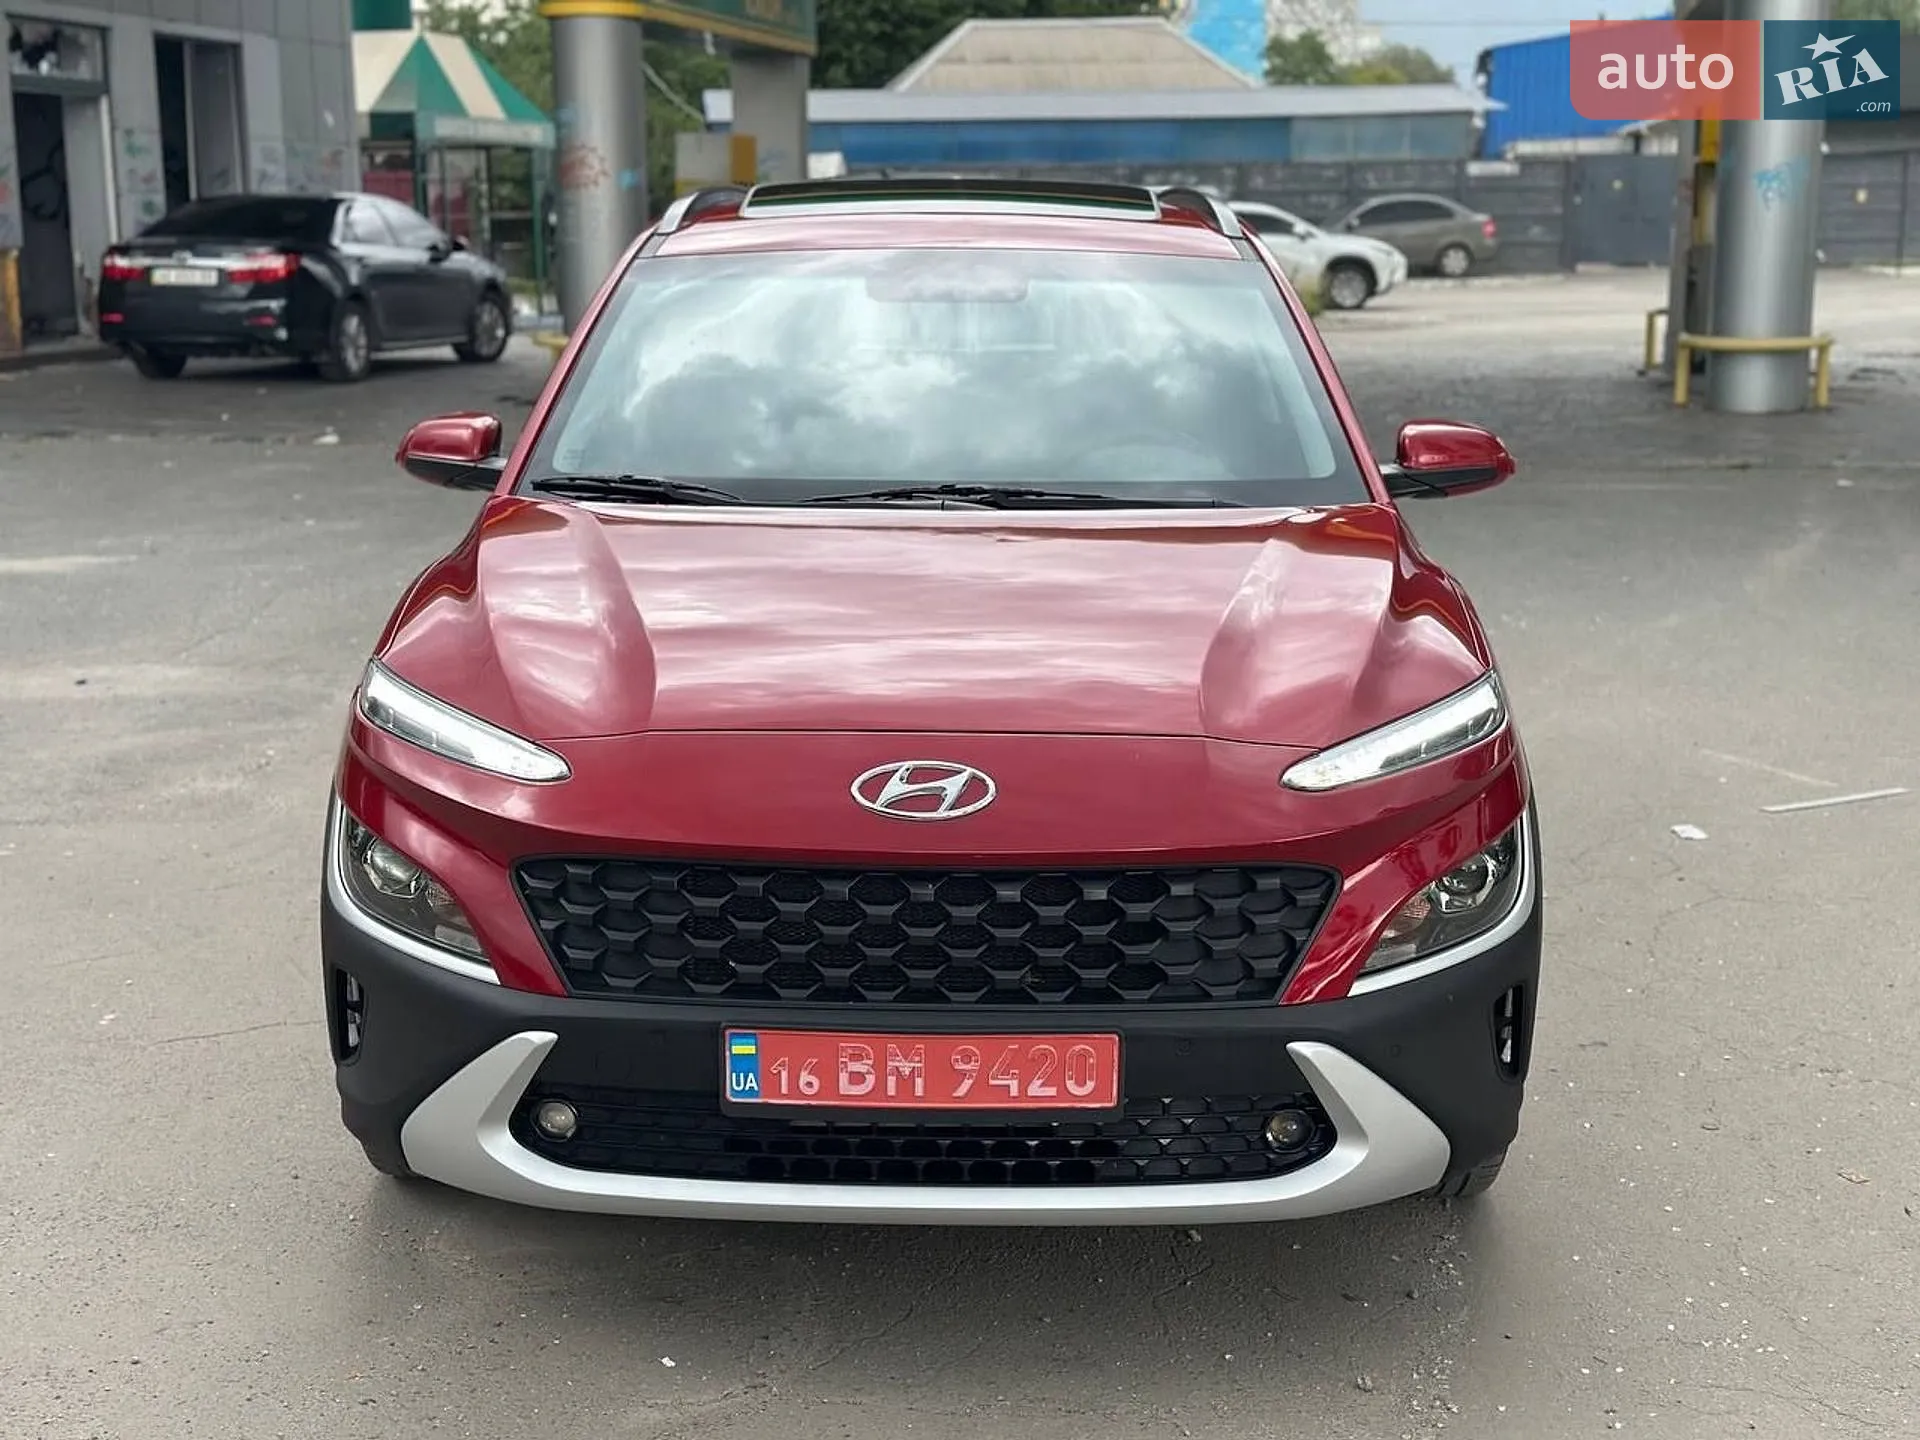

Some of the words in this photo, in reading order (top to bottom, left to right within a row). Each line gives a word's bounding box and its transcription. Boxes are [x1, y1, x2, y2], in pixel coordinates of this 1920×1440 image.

[731, 1072, 758, 1092] UA
[769, 1056, 821, 1096] 16
[838, 1042, 926, 1097] BM
[950, 1043, 1097, 1098] 9420
